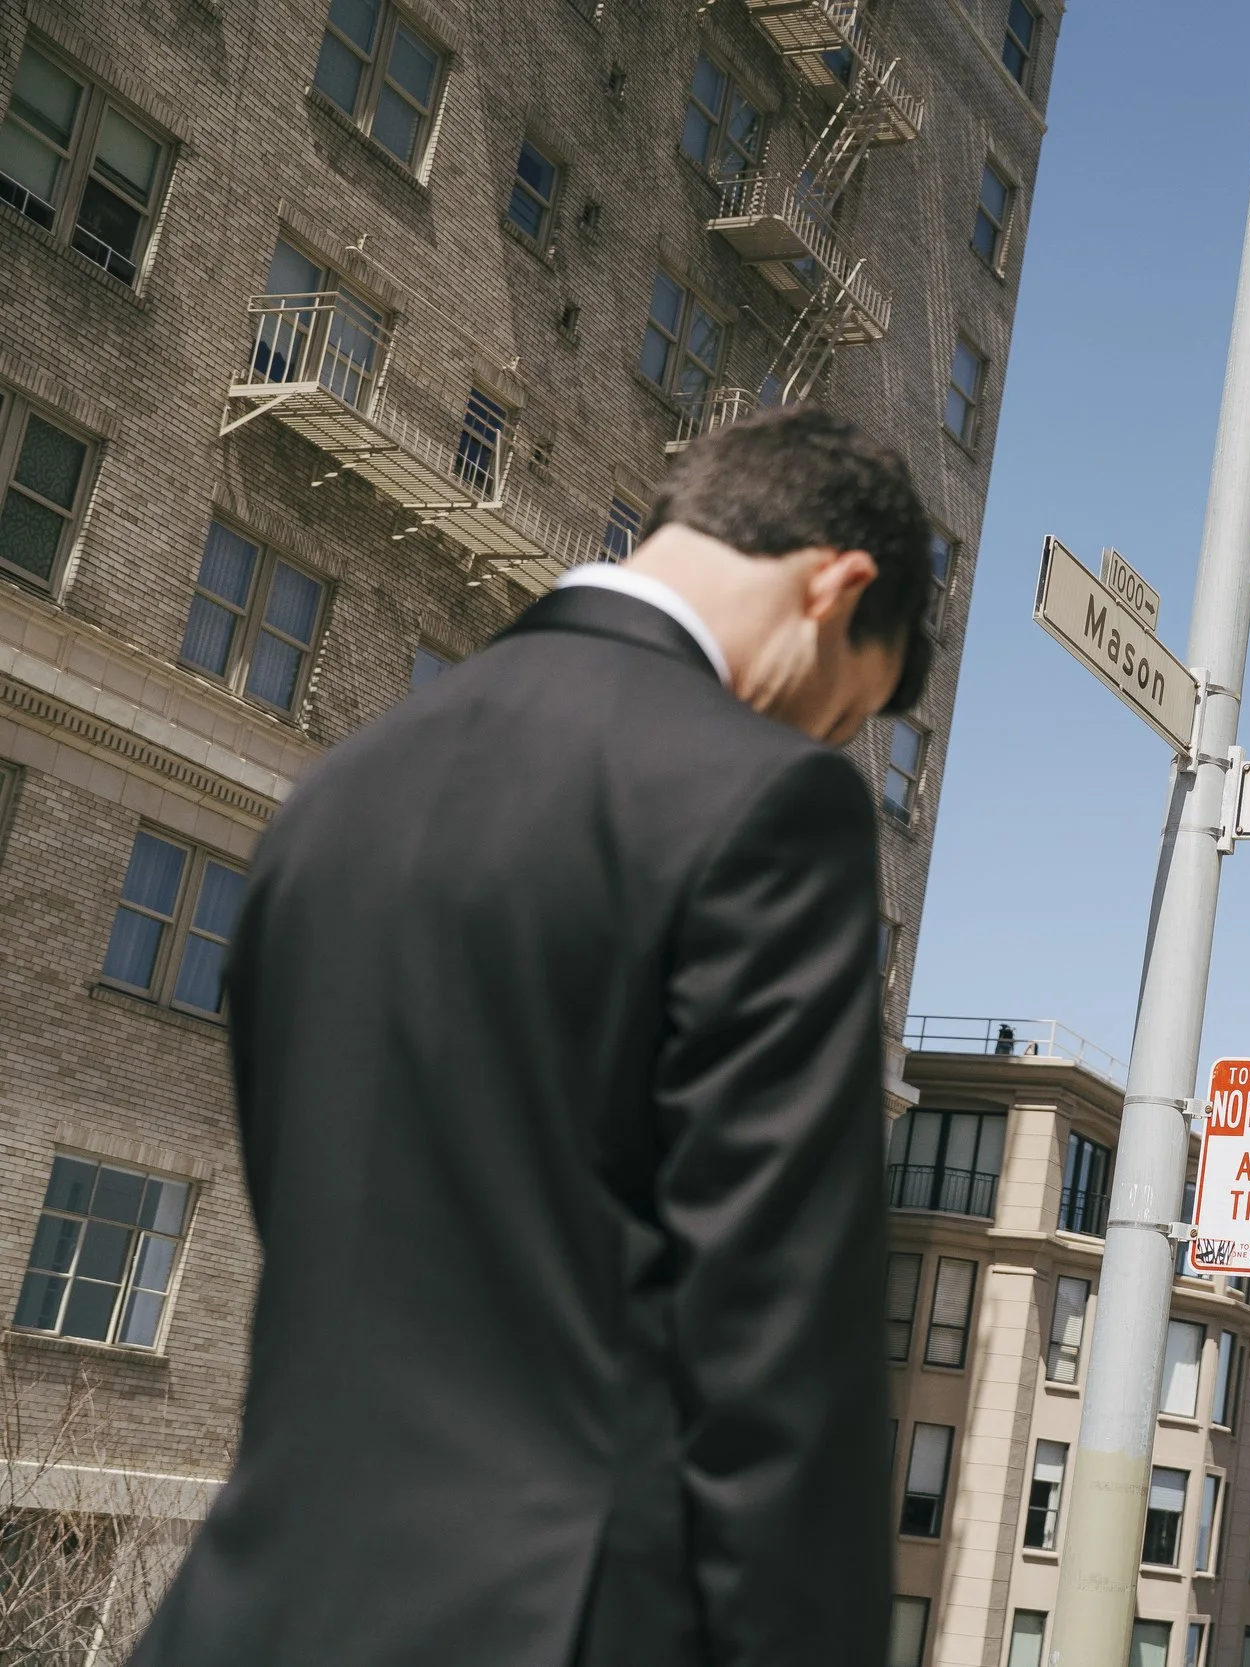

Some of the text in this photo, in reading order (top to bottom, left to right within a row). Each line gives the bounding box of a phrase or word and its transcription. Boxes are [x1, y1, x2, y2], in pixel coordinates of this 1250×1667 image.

[1112, 559, 1144, 611] 1000
[1084, 593, 1165, 706] Mason
[1211, 1090, 1243, 1129] NO
